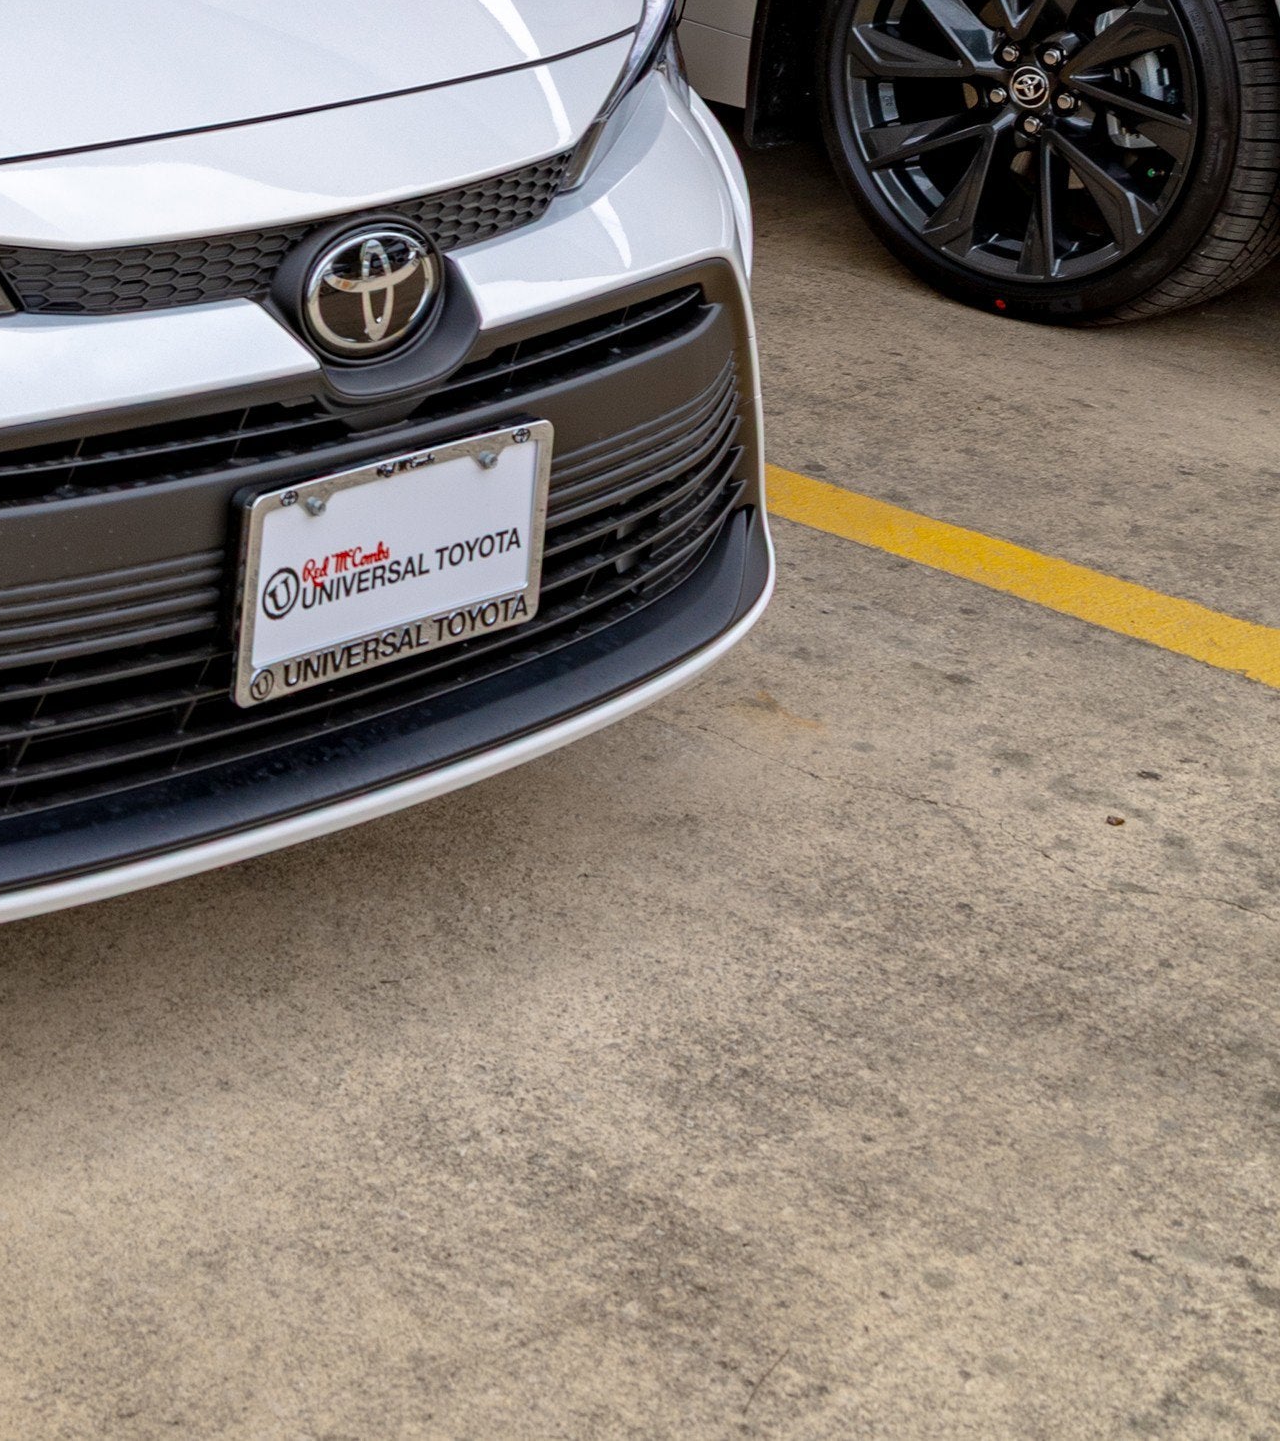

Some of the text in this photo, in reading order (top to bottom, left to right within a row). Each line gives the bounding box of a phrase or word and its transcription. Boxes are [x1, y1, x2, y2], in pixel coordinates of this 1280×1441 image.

[302, 527, 522, 610] UNIVERSAL TOYOTA
[302, 557, 330, 588] Red
[283, 623, 429, 687] UNIVERSAL
[432, 593, 529, 642] TOYOTA
